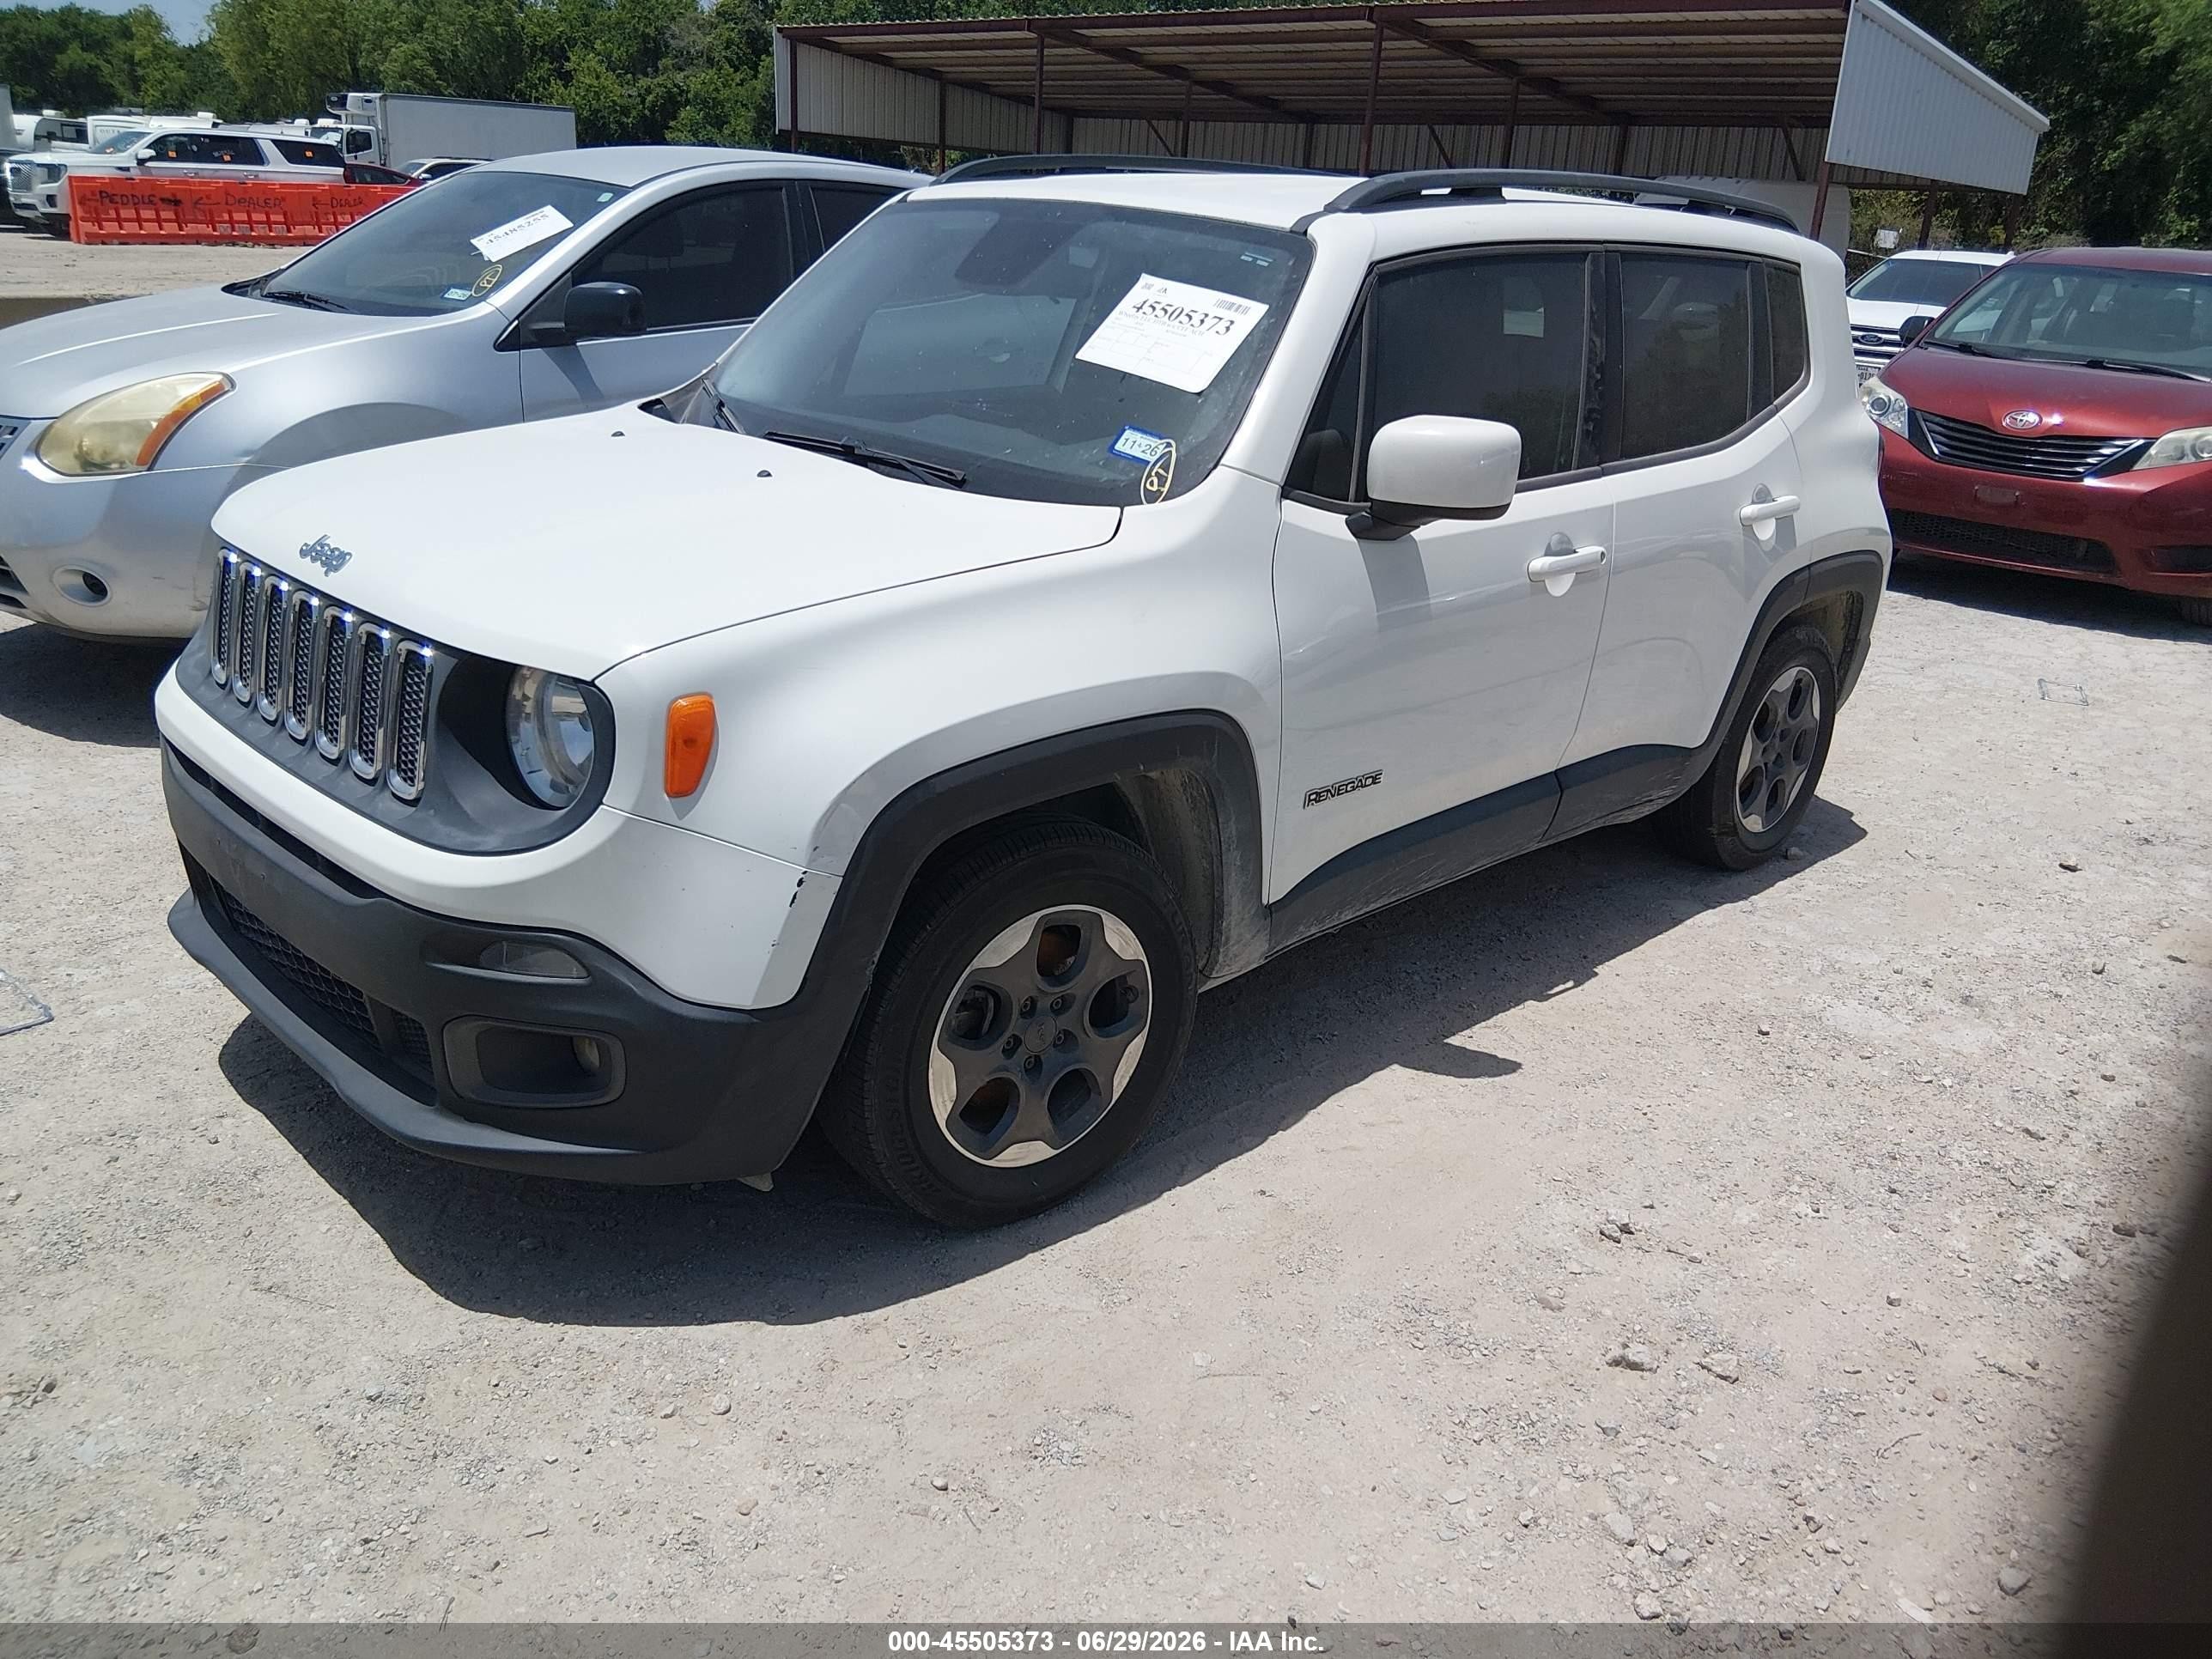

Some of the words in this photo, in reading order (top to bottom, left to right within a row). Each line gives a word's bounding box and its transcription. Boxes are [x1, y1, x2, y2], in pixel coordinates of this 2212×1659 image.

[99, 190, 157, 206] PEDDLE
[1132, 298, 1235, 336] 45505373
[299, 533, 352, 577] Jeep
[1304, 769, 1383, 809] RENEGADE
